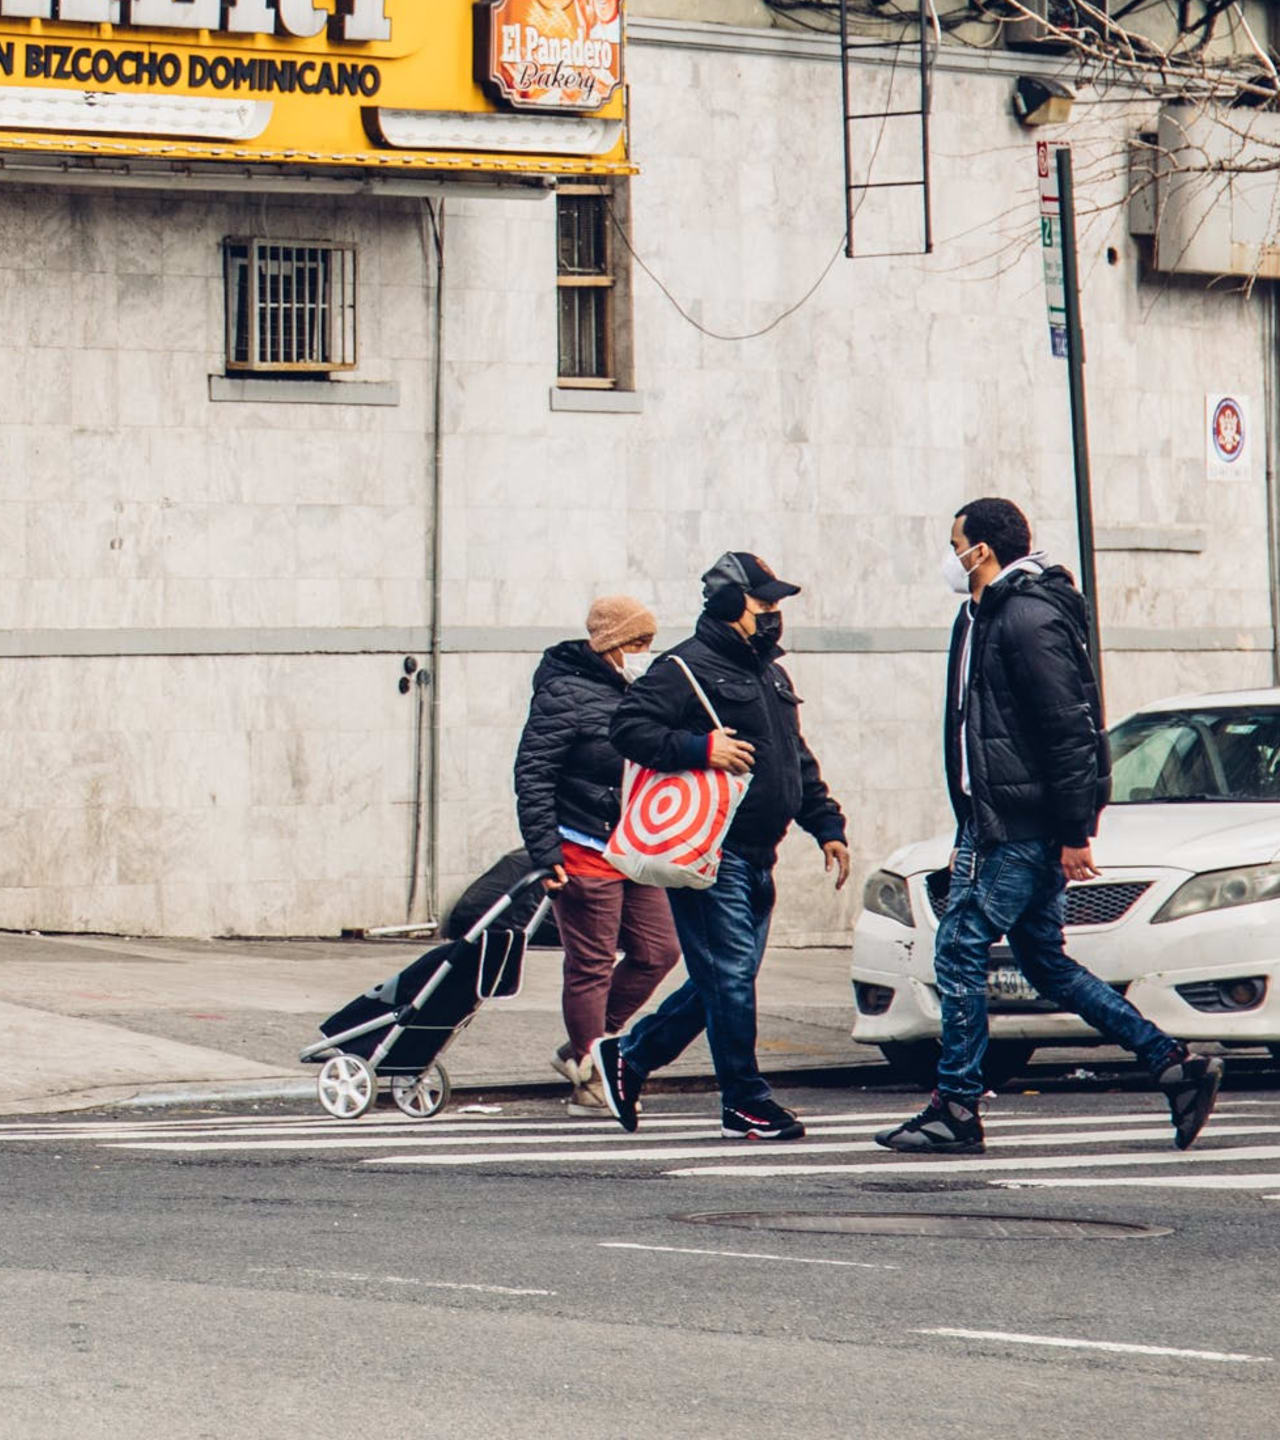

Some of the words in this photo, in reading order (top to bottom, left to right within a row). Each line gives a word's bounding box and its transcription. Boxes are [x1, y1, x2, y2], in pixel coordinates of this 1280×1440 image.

[25, 43, 183, 87] BIZCOCHO
[188, 54, 382, 97] DOMINICANO
[501, 22, 522, 63] El
[524, 26, 613, 70] Panadero
[518, 60, 596, 102] Bakery
